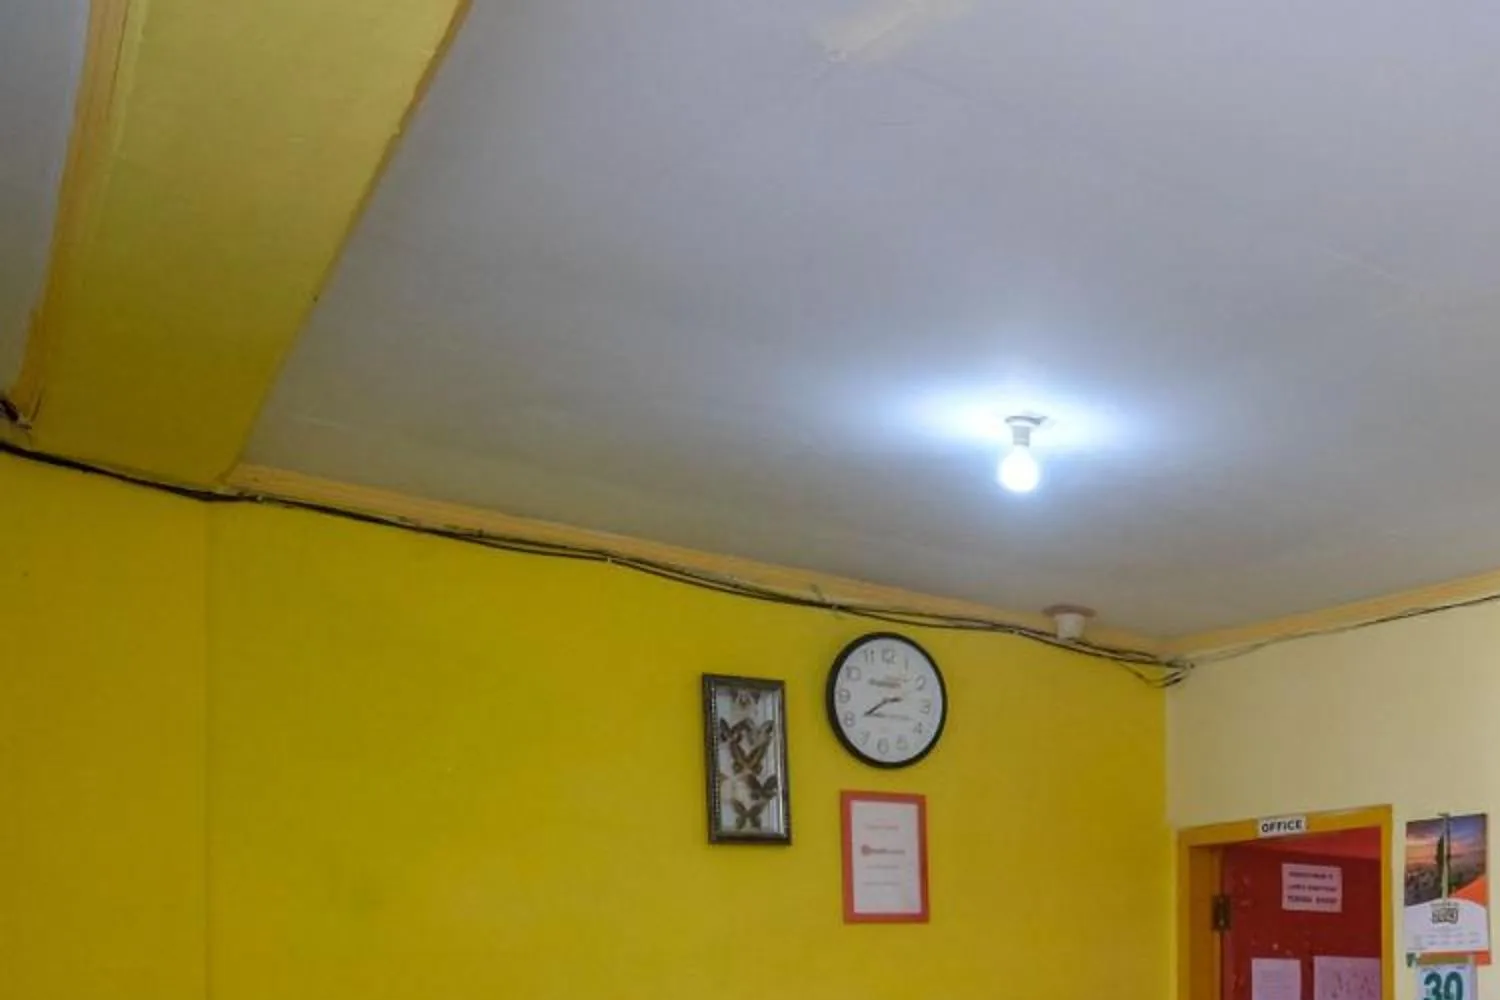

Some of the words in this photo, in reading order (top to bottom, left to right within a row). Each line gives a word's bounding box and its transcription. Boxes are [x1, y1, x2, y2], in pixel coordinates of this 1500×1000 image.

[881, 648, 896, 665] 12
[914, 674, 927, 692] 2
[843, 710, 856, 728] 8
[1261, 819, 1303, 833] OFFICE
